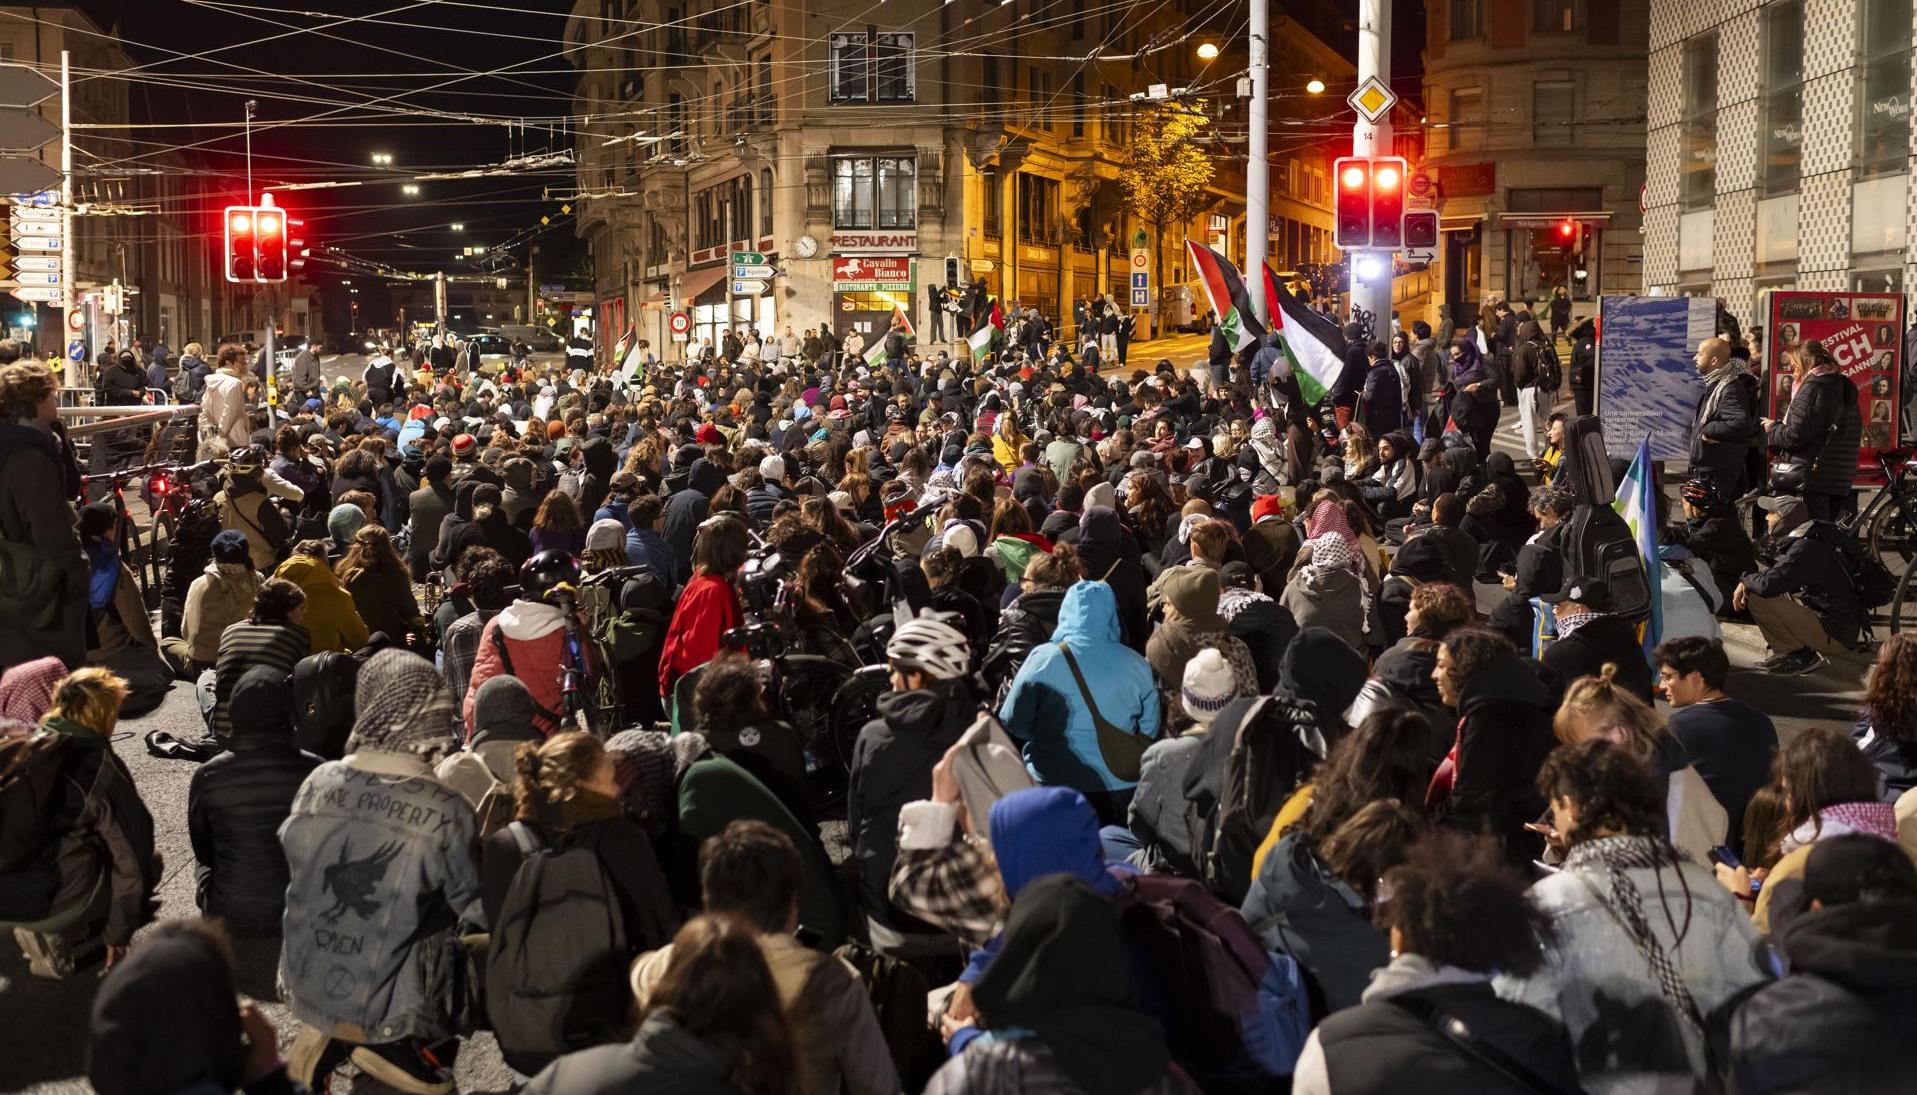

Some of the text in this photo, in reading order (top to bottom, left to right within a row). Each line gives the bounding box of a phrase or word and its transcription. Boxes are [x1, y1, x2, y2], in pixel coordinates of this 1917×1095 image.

[1363, 132, 1373, 141] 14
[832, 235, 917, 247] RESTAURANT
[863, 258, 897, 268] Cavallo
[874, 268, 907, 278] Bianco
[839, 283, 910, 291] RISTORANTE PIZZERIA
[675, 319, 684, 327] 30
[1820, 323, 1864, 348] ESTIVAL
[1833, 333, 1873, 366] CH
[1841, 356, 1878, 378] SANNE
[357, 791, 453, 834] PROPERTY
